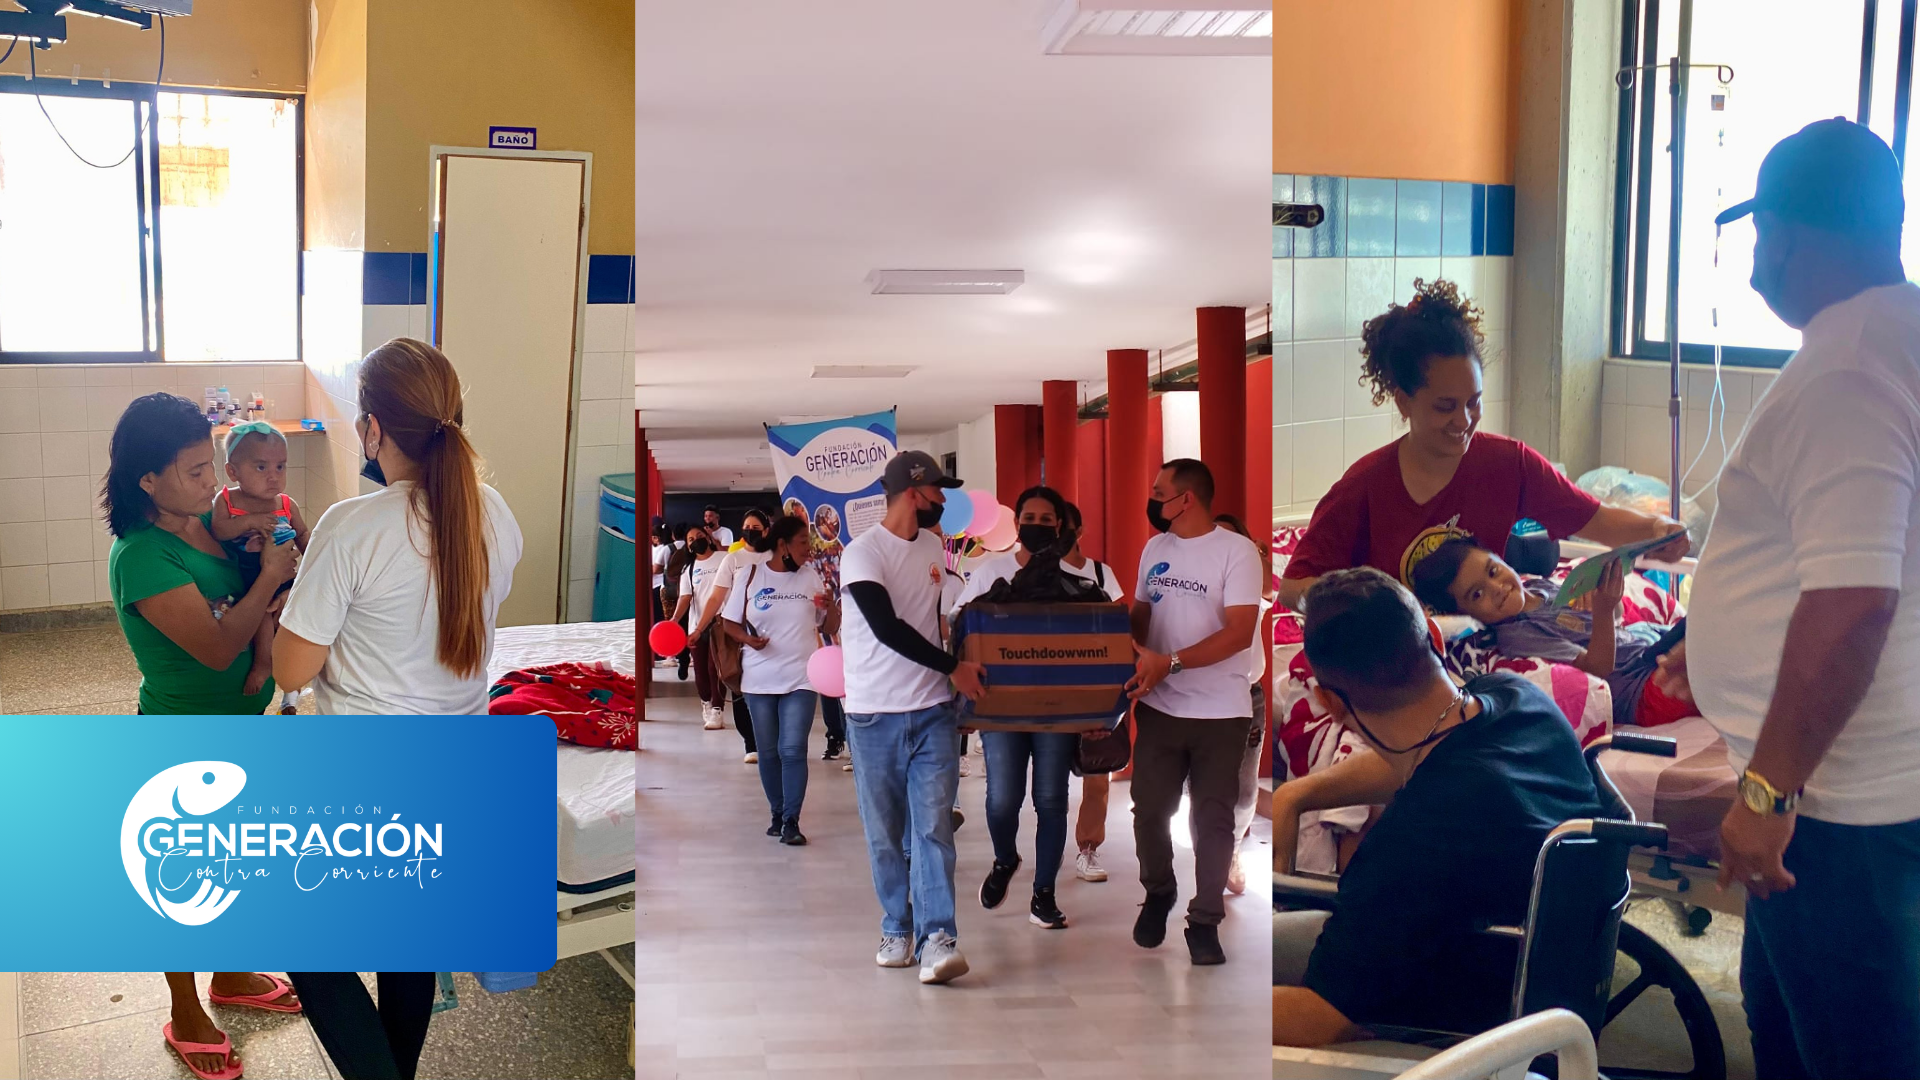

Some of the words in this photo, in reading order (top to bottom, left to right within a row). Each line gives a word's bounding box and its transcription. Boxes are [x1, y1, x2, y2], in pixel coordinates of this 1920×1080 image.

[497, 134, 529, 145] BAÑO
[824, 442, 863, 453] FUNDACIÓN
[805, 442, 887, 472] GENERACIÓN
[1147, 575, 1208, 593] GENERACIÓN
[998, 646, 1108, 660] Touchdoowwnn!
